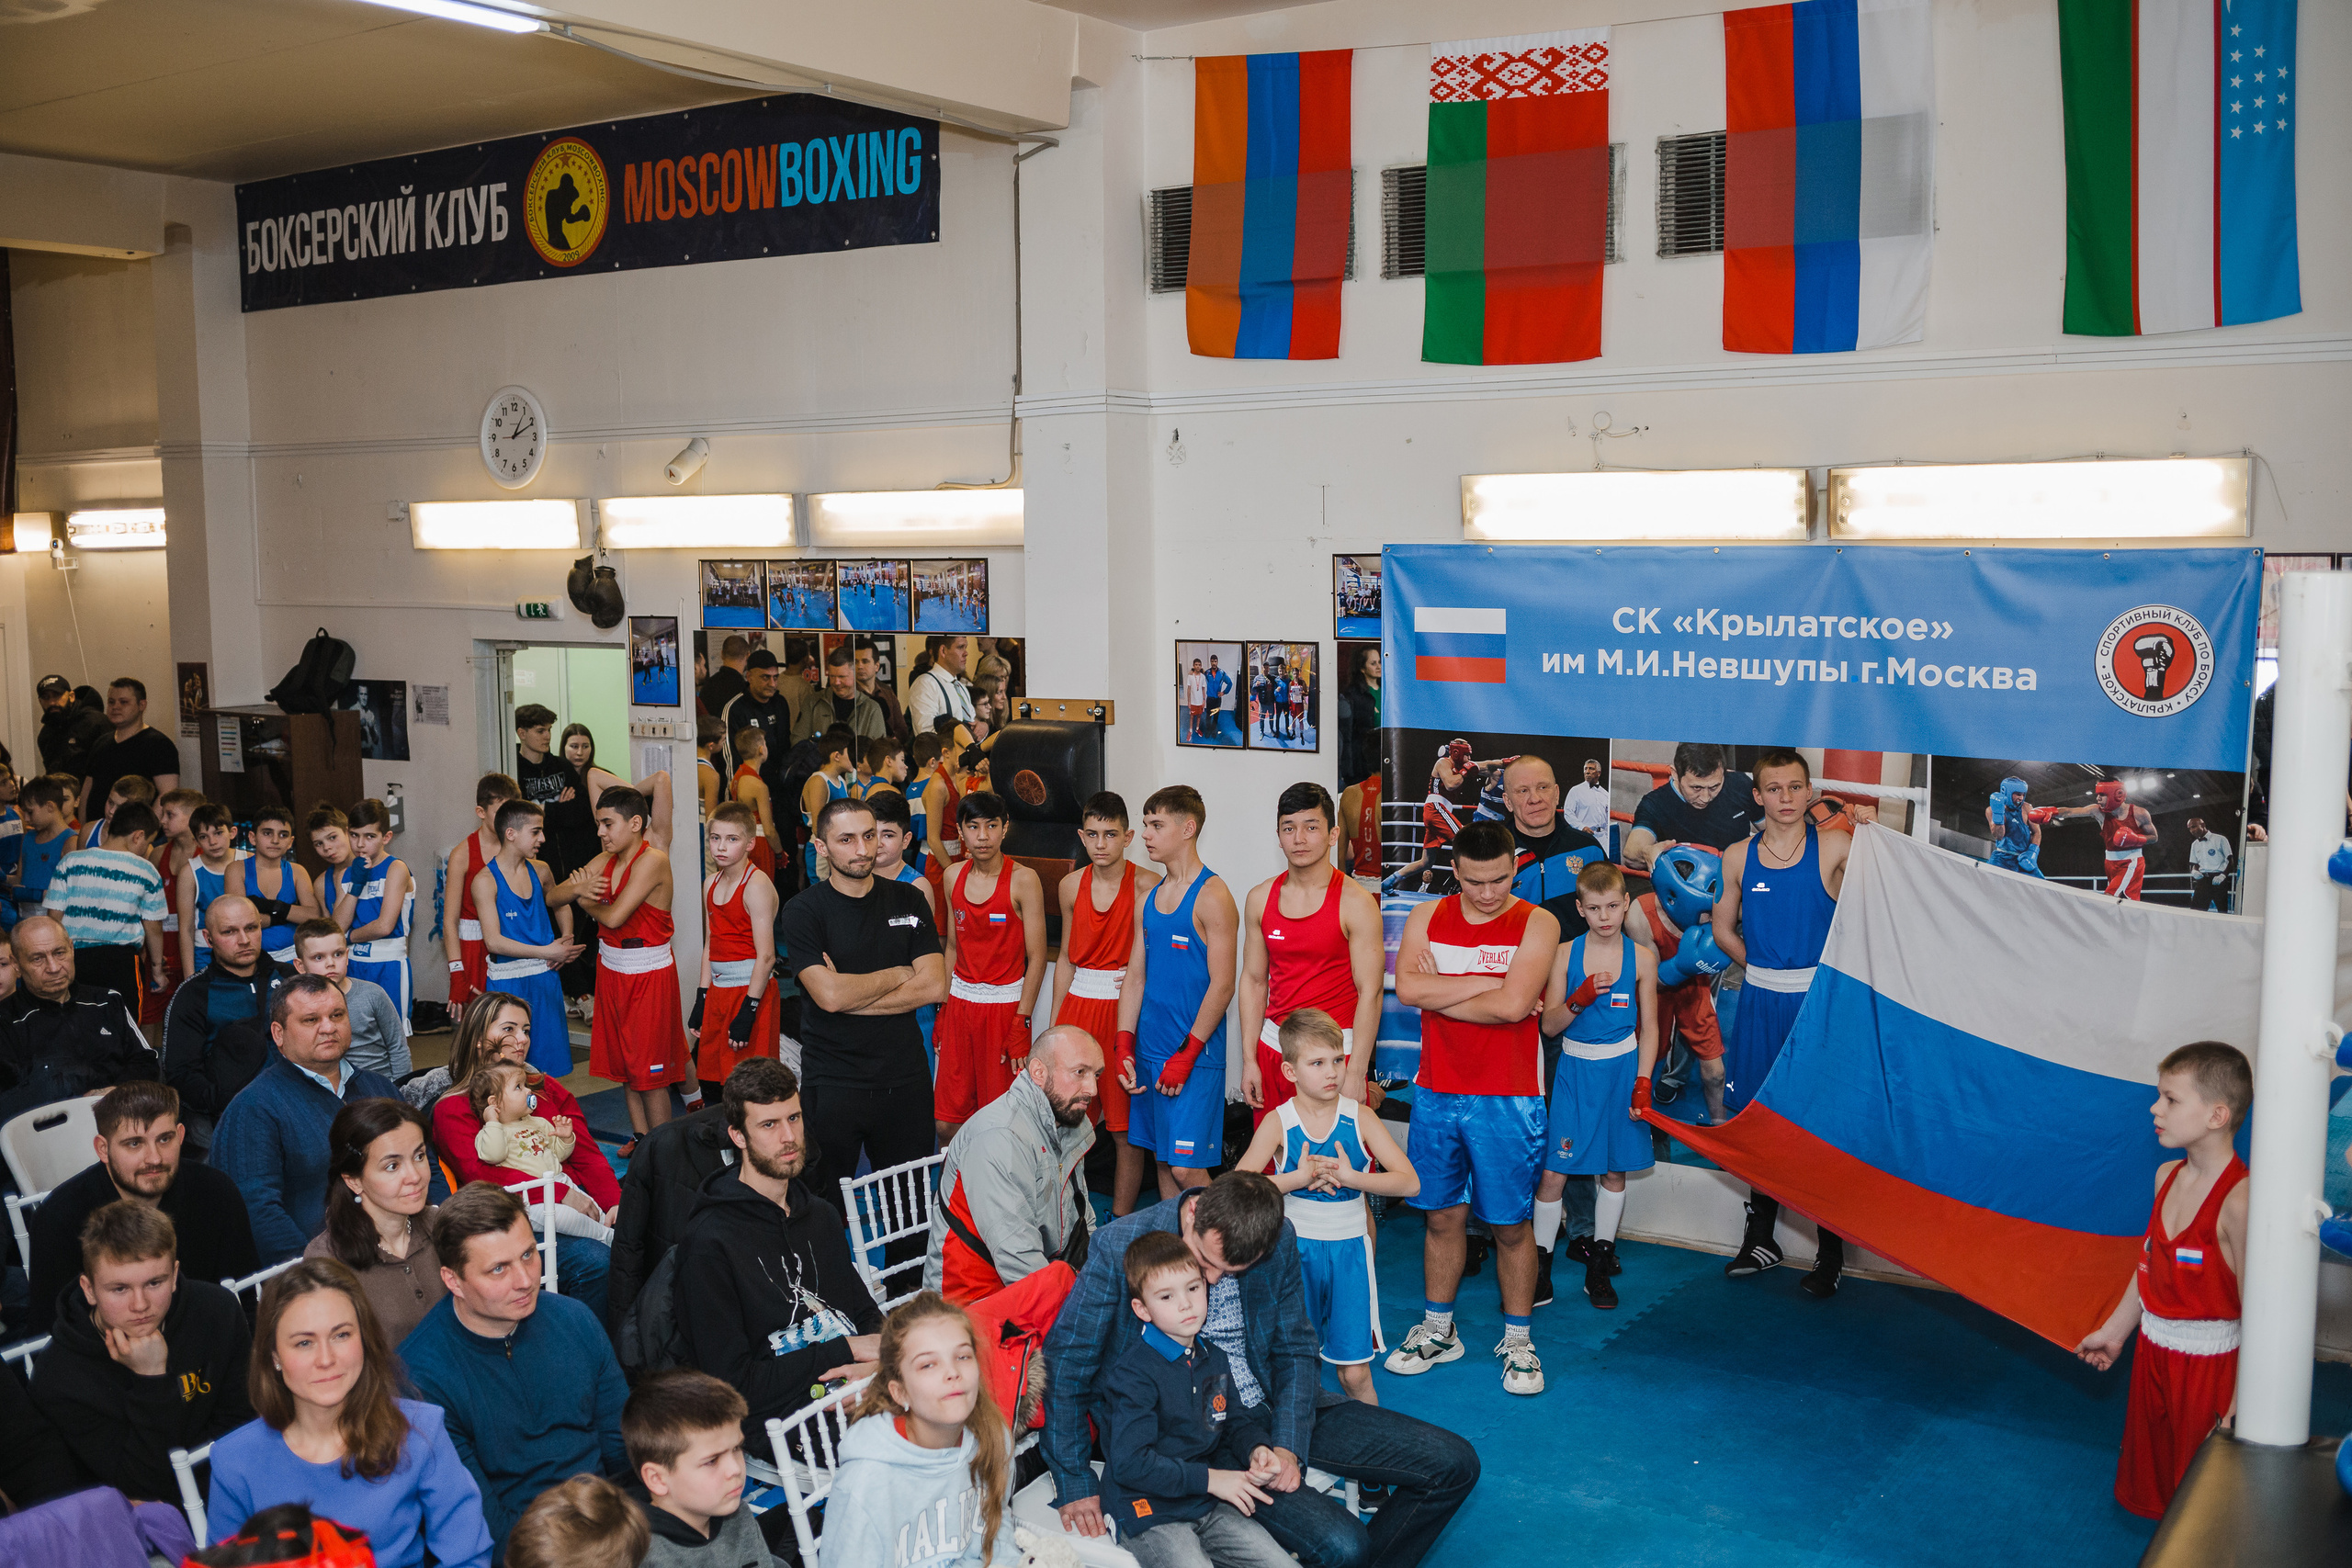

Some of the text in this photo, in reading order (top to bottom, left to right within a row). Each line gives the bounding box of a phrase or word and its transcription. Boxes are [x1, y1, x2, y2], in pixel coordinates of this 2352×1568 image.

[546, 144, 565, 159] КЛУБ
[566, 144, 605, 203] MOSCOWBOXING
[246, 182, 509, 275] БОКСЕРСКИЙ КЛУБ
[562, 250, 581, 262] 2009
[502, 407, 507, 416] 11
[511, 402, 518, 412] 12
[523, 406, 526, 415] 1
[494, 418, 503, 427] 10
[529, 417, 534, 426] 2
[492, 434, 496, 442] 9
[532, 432, 537, 442] 3
[494, 448, 500, 457] 8
[528, 448, 534, 457] 4
[503, 459, 507, 468] 7
[512, 463, 516, 472] 6
[522, 458, 527, 468] 5
[1612, 606, 1954, 642] СК «Крылатское»
[2100, 608, 2210, 703] СПОРТИВНЫЙ КЛУБ ПО БОКСУ
[1542, 649, 2038, 692] им М.И.Невшупы г.Москва
[2101, 672, 2174, 714] КРЫЛАТСКОЕ
[1477, 949, 1510, 965] EVERLAST
